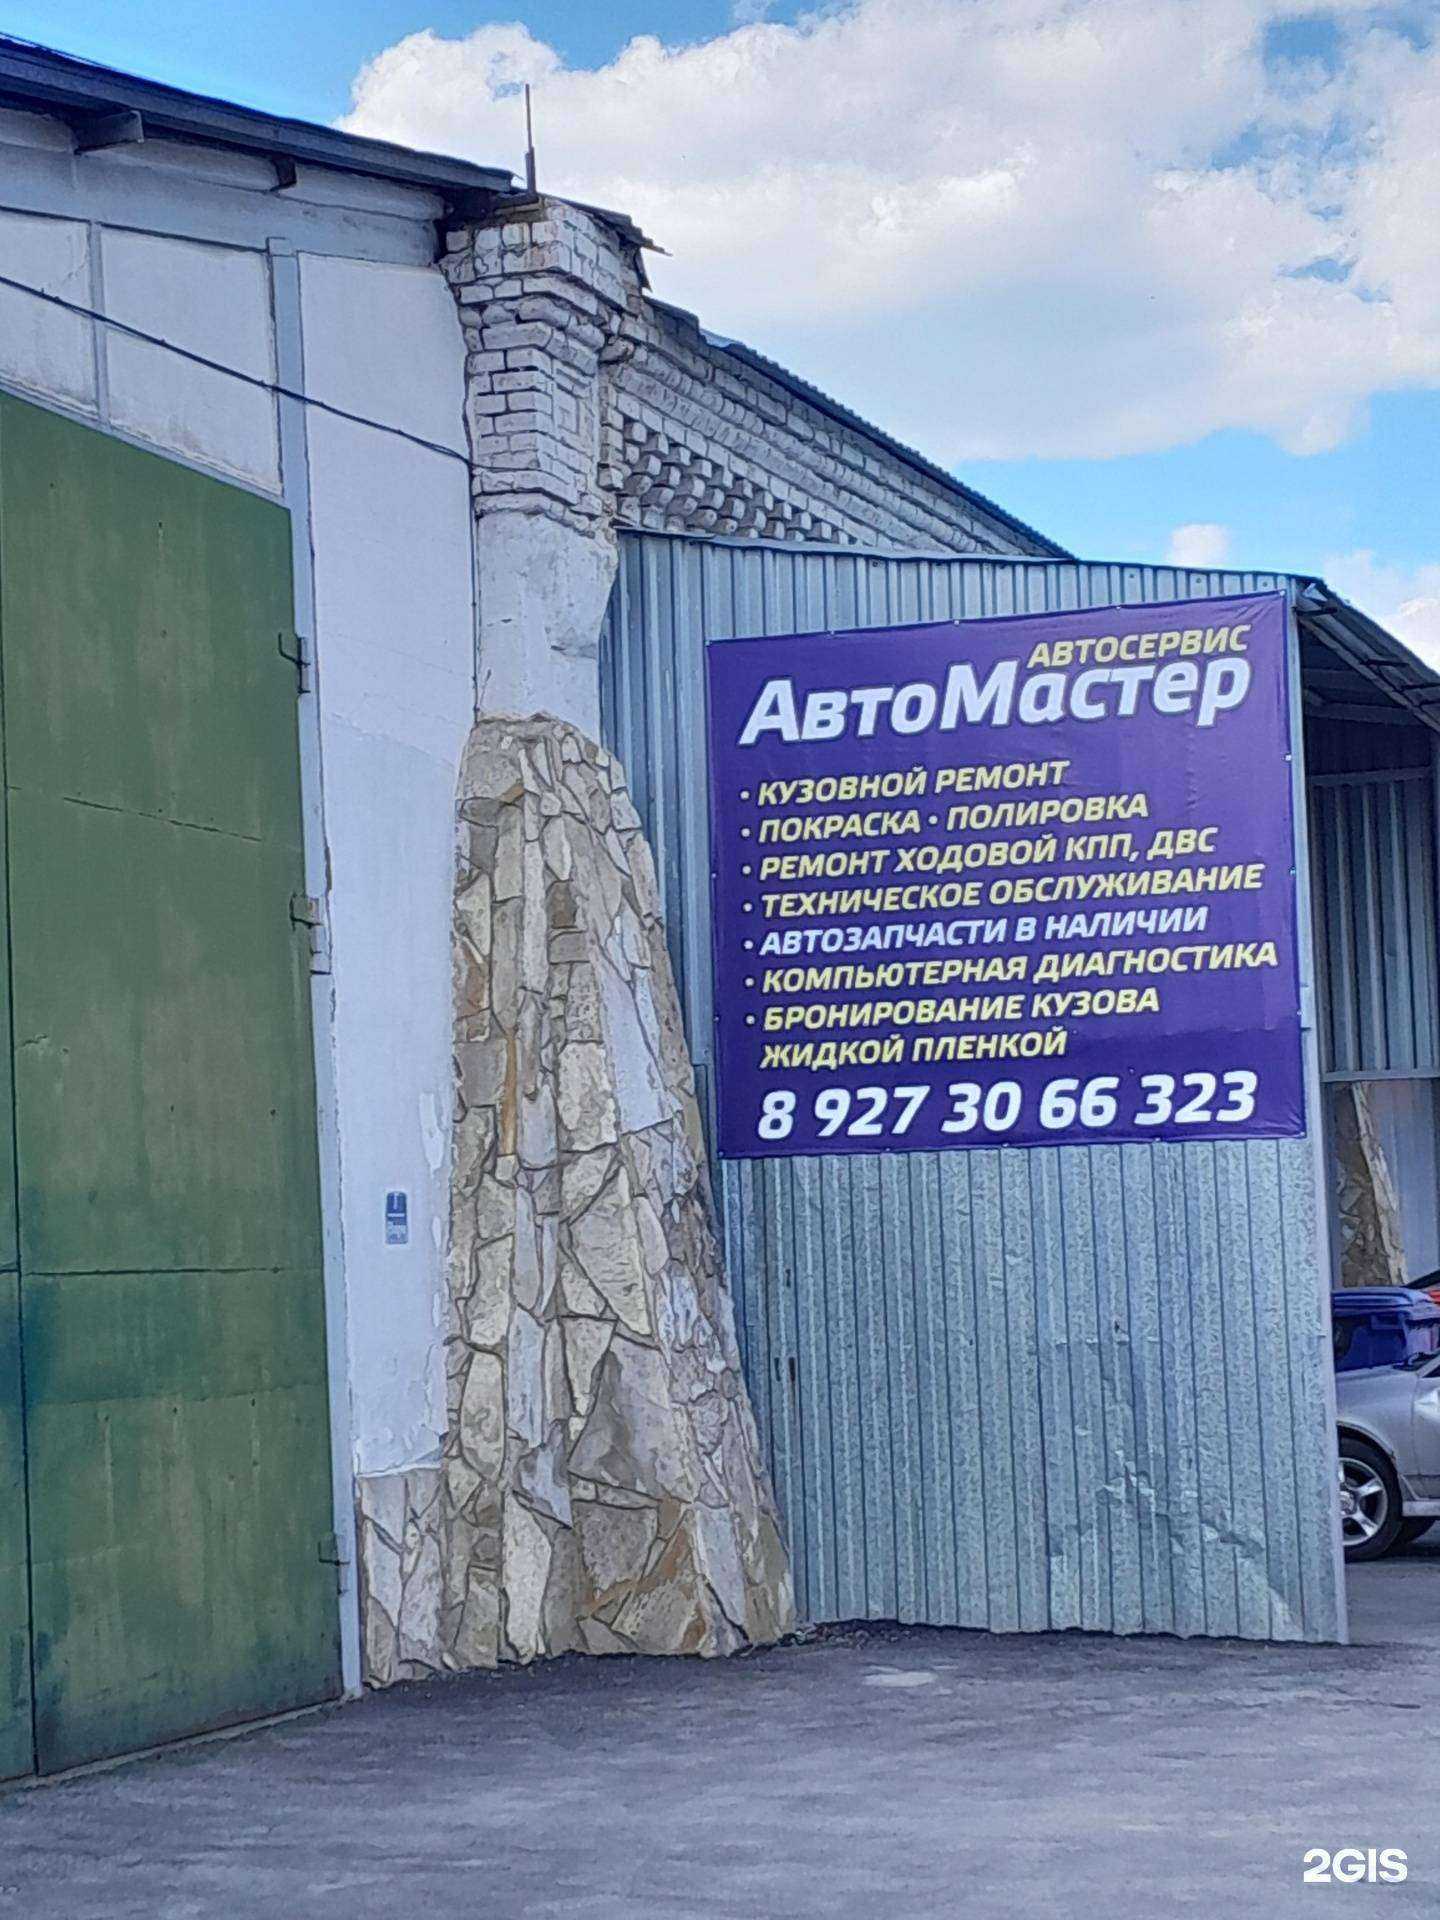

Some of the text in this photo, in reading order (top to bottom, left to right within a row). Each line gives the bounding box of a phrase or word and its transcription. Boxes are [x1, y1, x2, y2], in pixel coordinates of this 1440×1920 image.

[1027, 623, 1252, 669] АВТОСЕРВИС
[738, 654, 1252, 747] АвтоМастер
[757, 760, 1070, 807] КУЗОВНОЙ РЕМОНТ
[758, 793, 1148, 844] ПОКРАСКА ПОЛИРОВКА
[759, 826, 1218, 882] РЕМОНТ ХОДОВОЙ КПП, ДВС
[761, 864, 1266, 918] ТЕХНИЧЕСКОЕ ОБСЛУЖИВАНИЕ
[759, 906, 1208, 956] АВТОЗАПЧАСТИ В НАЛИЧИИ
[762, 941, 1278, 994] КОМПЬЮТЕРНАЯ ДИАГНОСТИКА
[763, 987, 1160, 1033] БРОНИРОВАНИЕ КУЗОВА
[759, 1025, 1068, 1072] ЖИДКОЙ ПЛЕНКОЙ
[757, 1070, 1259, 1140] 8 927 30 66 323
